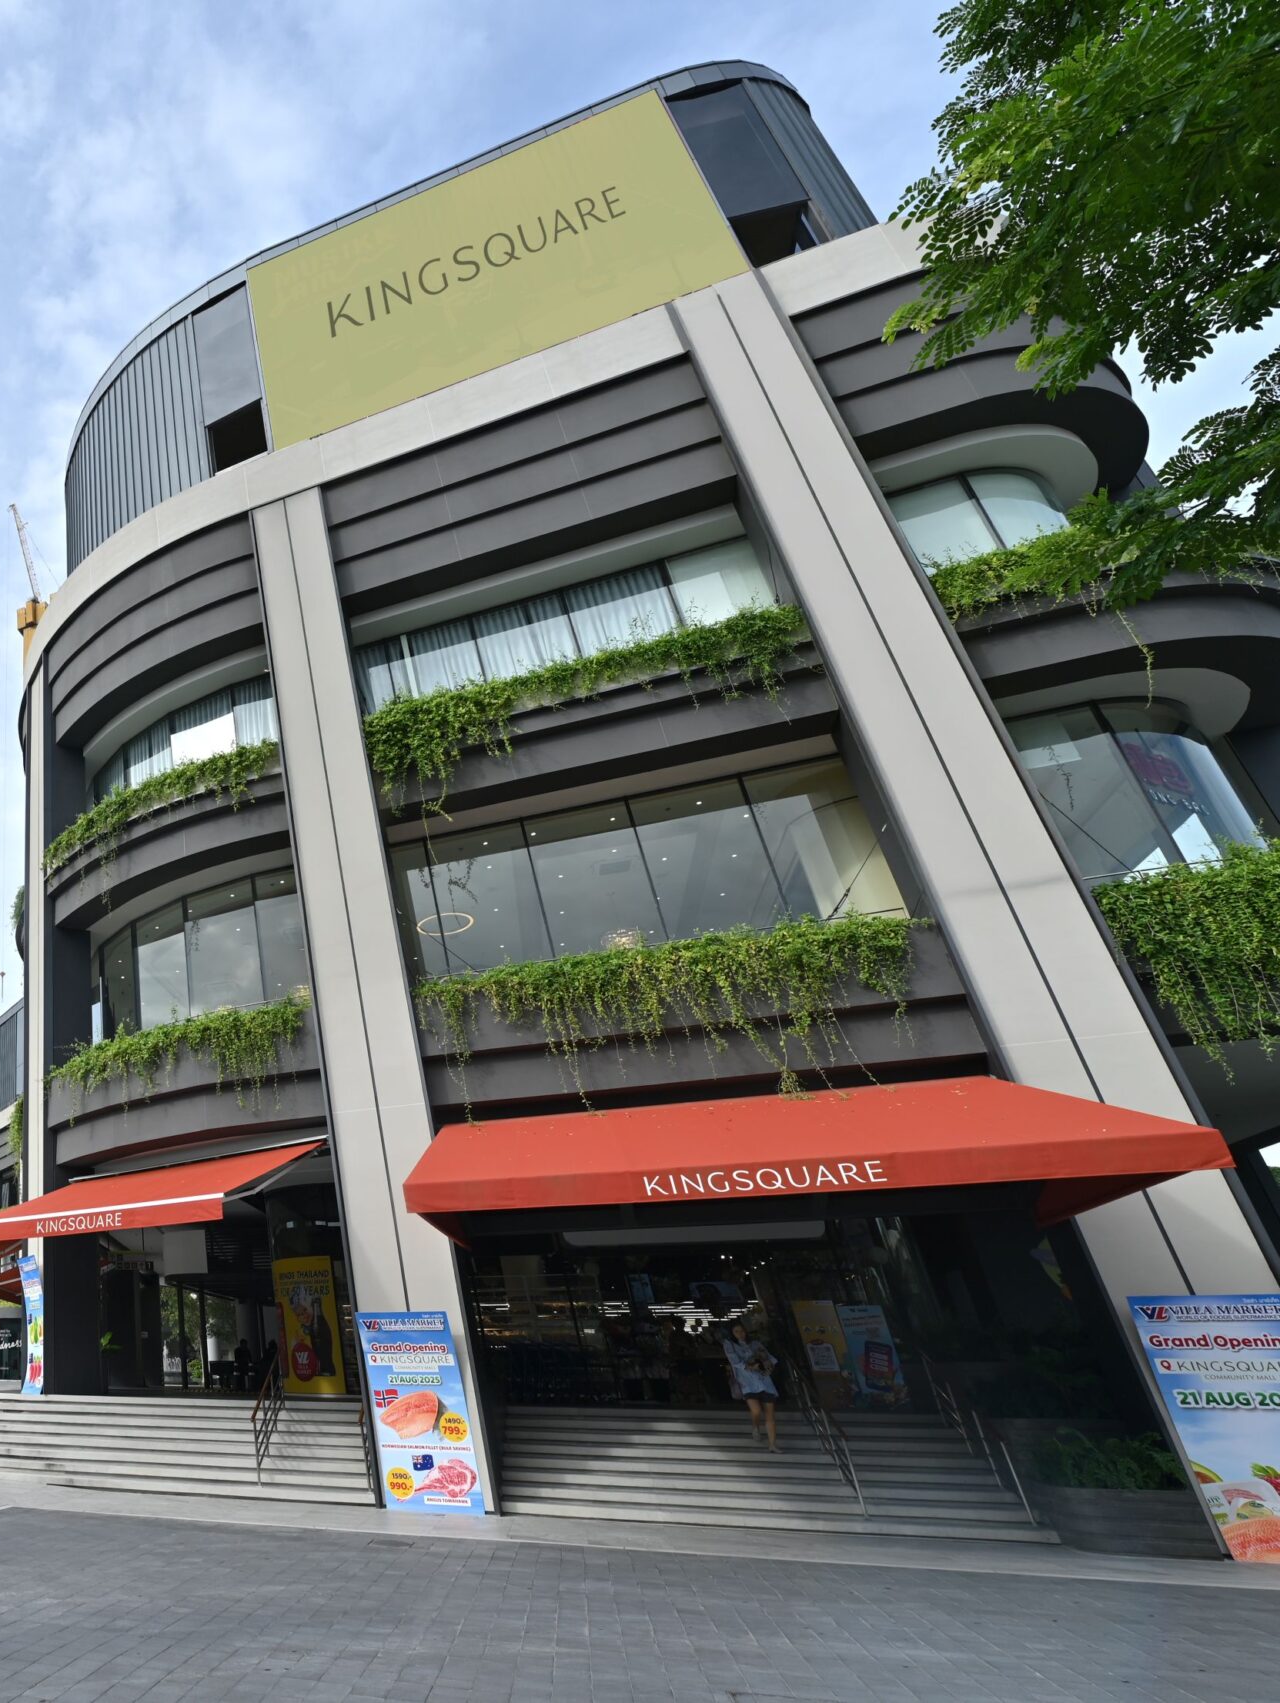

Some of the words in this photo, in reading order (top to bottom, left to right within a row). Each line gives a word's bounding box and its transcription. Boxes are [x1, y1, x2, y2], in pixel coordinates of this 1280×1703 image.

[327, 186, 626, 338] KINGSQUARE
[643, 1160, 888, 1196] KINGSQUARE
[35, 1212, 123, 1234] KINGSQUARE
[1169, 1305, 1212, 1315] VILLA
[1149, 1334, 1211, 1348] Grand
[371, 1343, 402, 1352] Grand
[404, 1342, 447, 1353] Opening
[379, 1355, 451, 1364] KINGSQUARE
[1177, 1360, 1280, 1372] KINGSQUA
[389, 1375, 398, 1384] 21
[400, 1375, 418, 1384] AUG
[420, 1375, 441, 1384] 2025
[1176, 1391, 1200, 1405] 21
[1205, 1391, 1252, 1406] AUG
[441, 1426, 467, 1435] 799.-
[389, 1481, 412, 1491] 990.-
